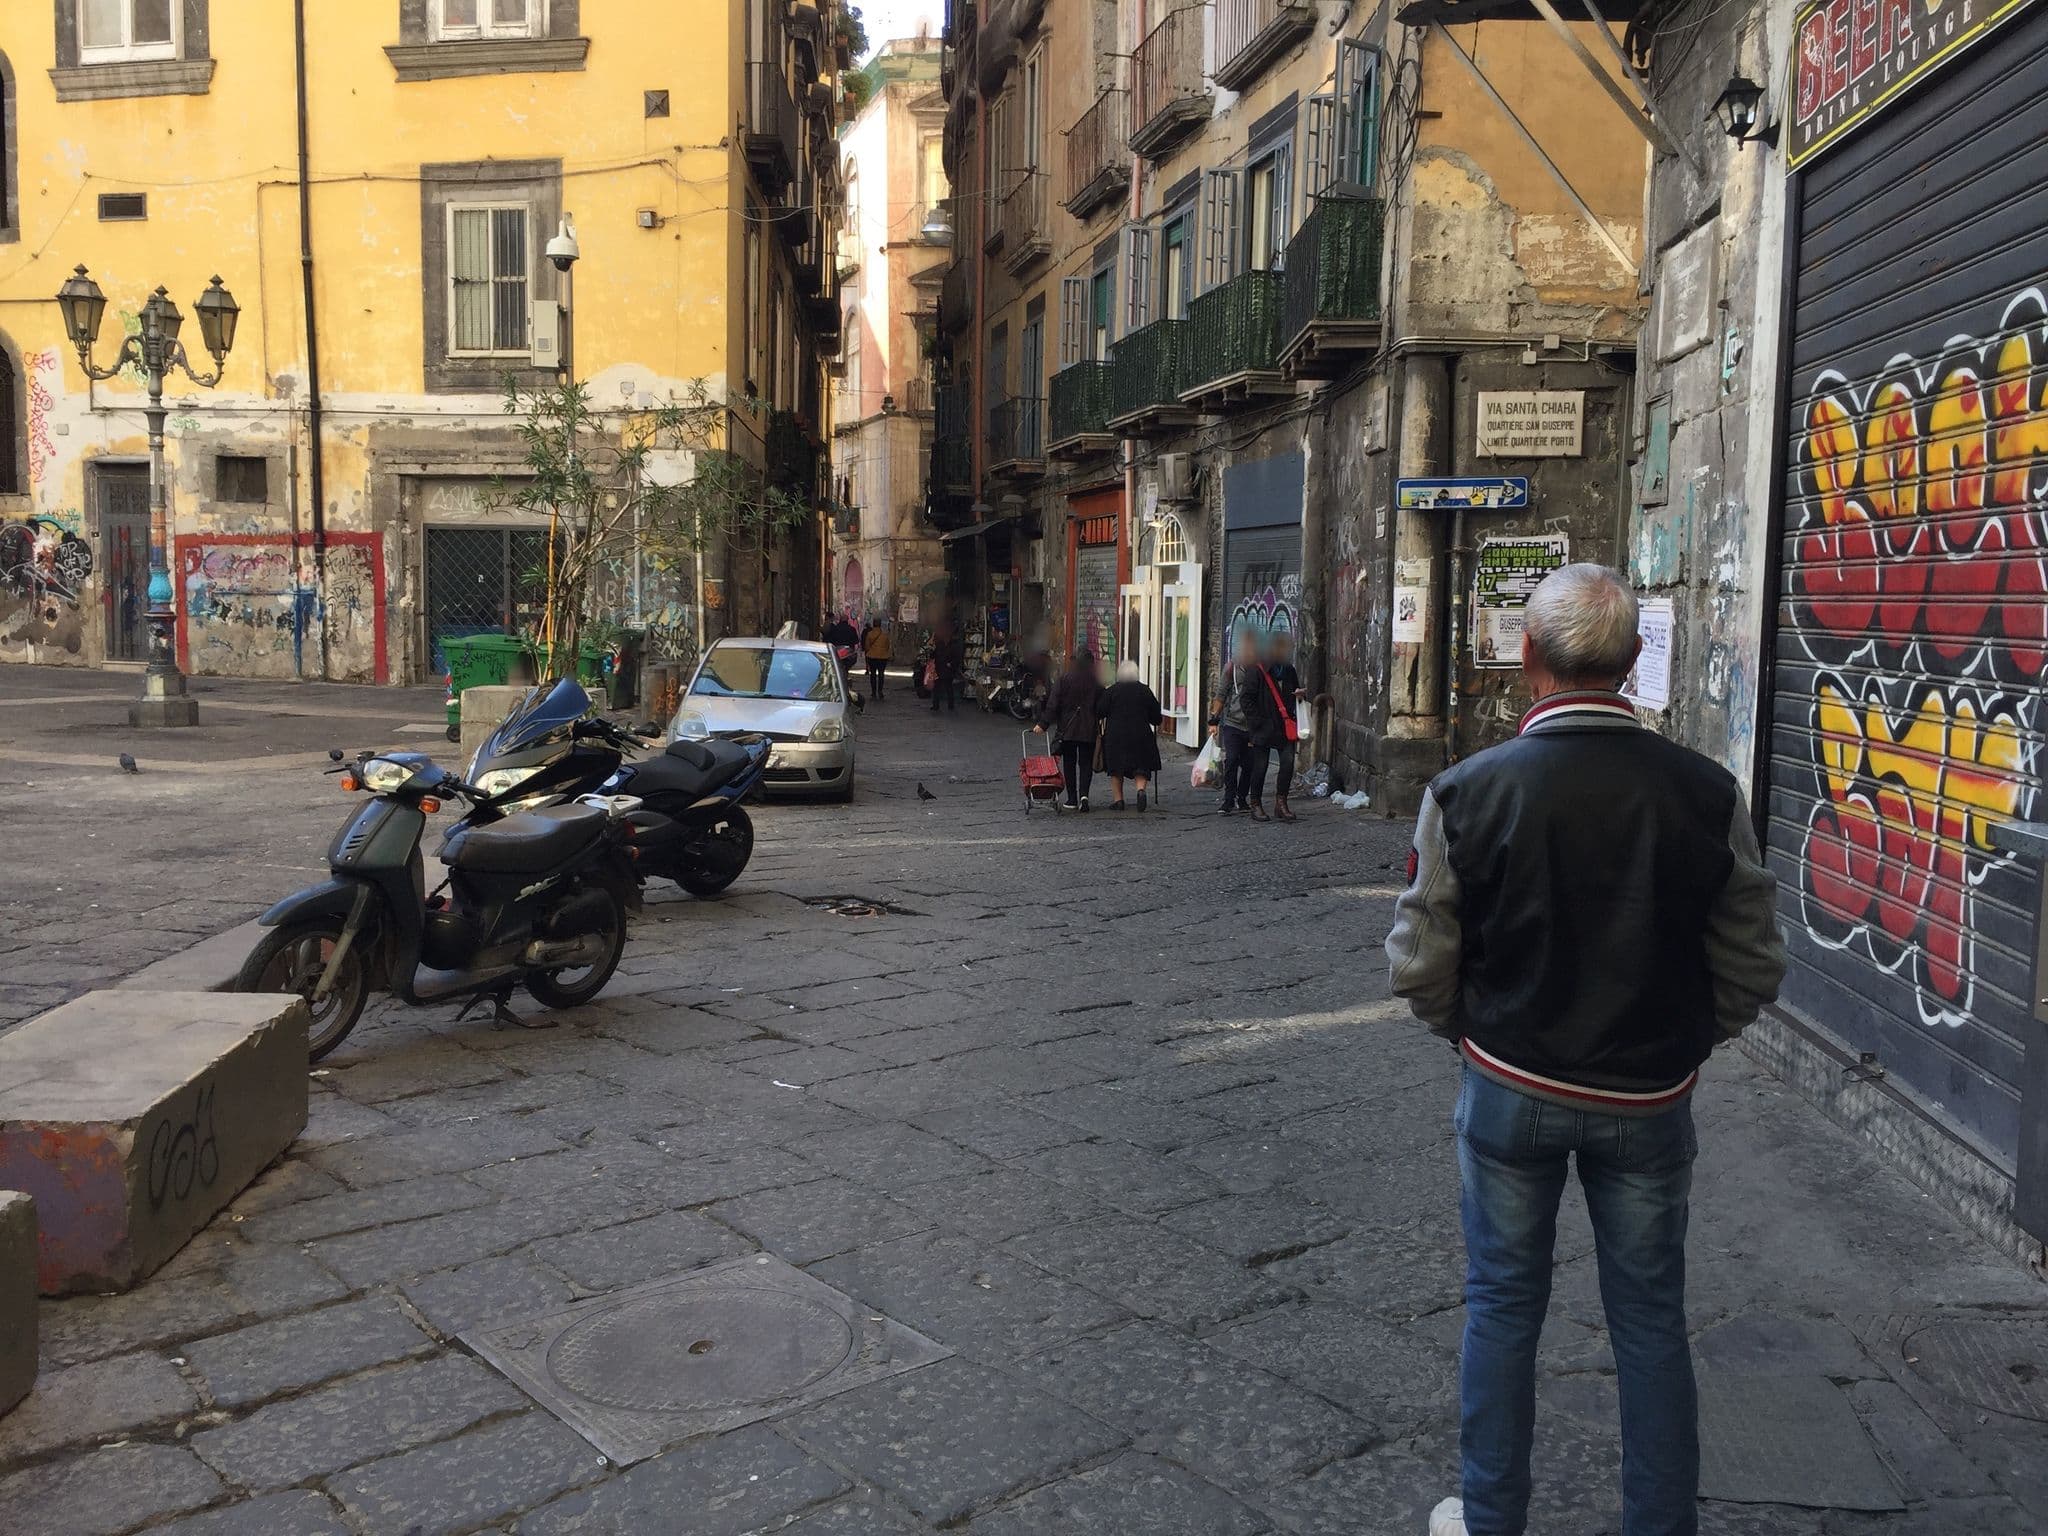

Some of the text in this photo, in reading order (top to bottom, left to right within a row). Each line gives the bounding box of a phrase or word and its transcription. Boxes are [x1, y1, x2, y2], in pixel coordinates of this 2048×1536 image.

[1804, 84, 1861, 144] DRINK
[1884, 0, 1973, 83] LOUNGE
[1487, 402, 1577, 415] VIA SANTA CHIARA
[1487, 420, 1575, 432] QUARTIERE SAN GIUSEPPE
[1487, 437, 1575, 448] LIMITE QUARTIERE PORTO
[1483, 547, 1545, 558] COMMONS
[1483, 557, 1509, 567] AND
[1478, 573, 1498, 592] 17
